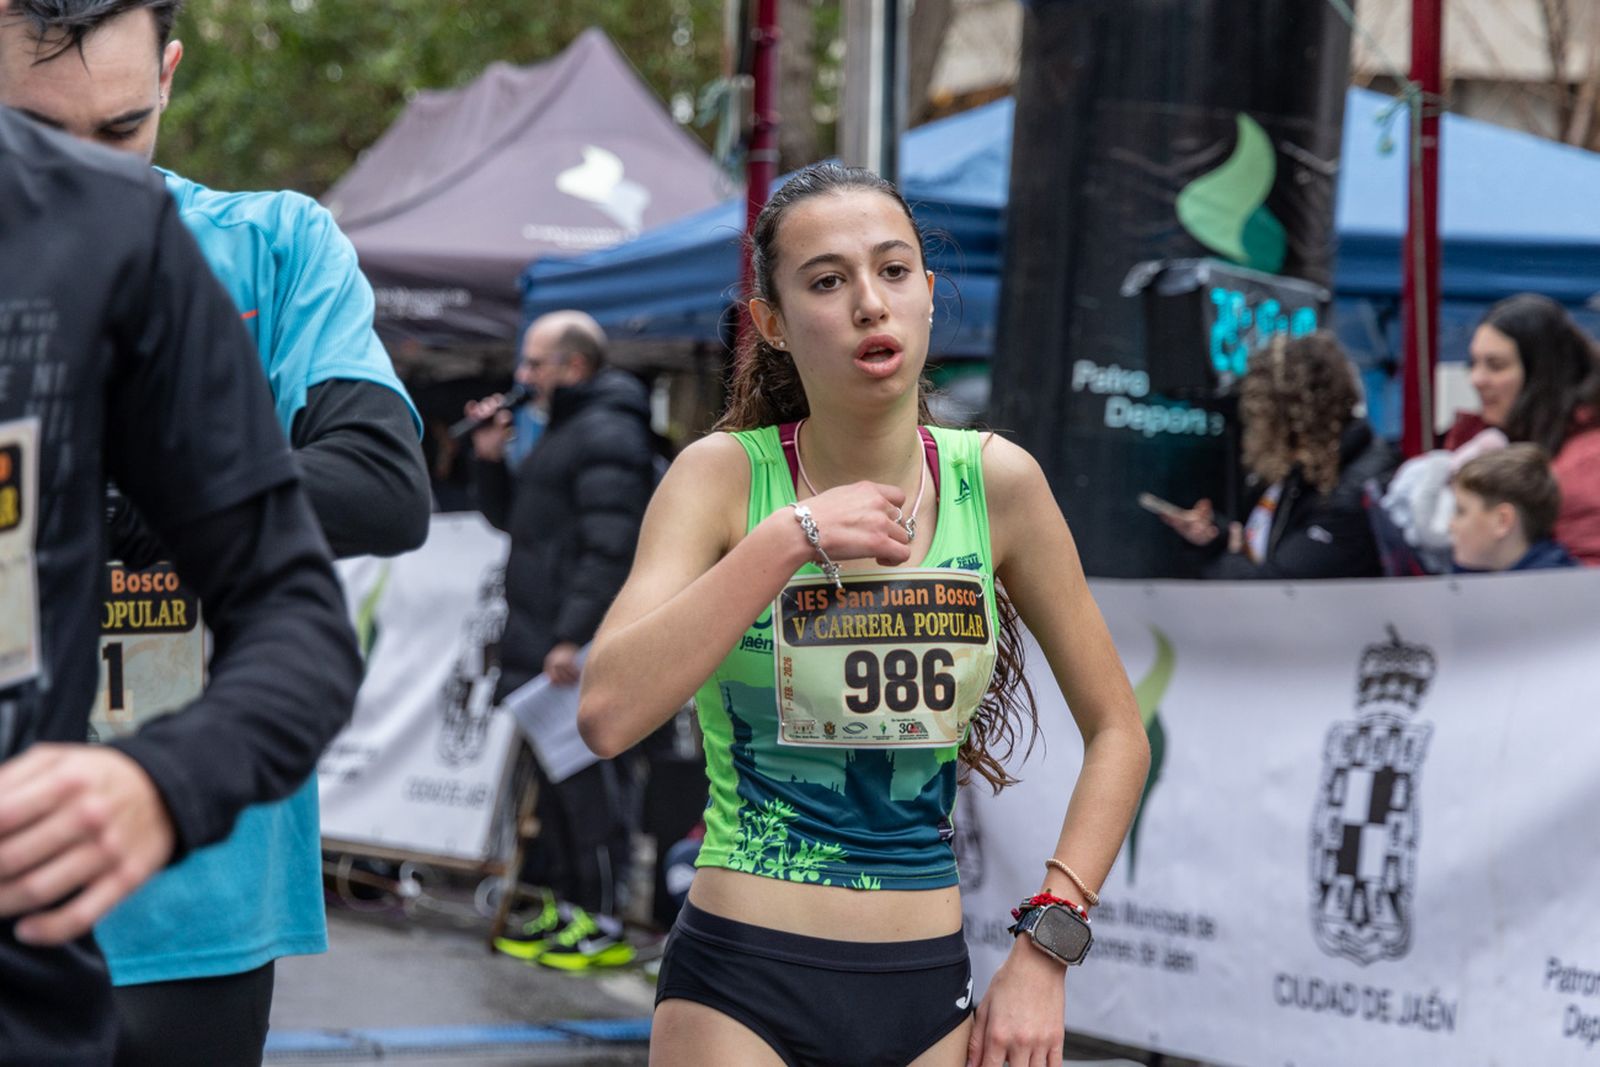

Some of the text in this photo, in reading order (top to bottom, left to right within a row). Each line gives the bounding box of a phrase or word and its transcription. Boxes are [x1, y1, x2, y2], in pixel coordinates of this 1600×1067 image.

[111, 569, 180, 594] Bosco
[797, 583, 977, 611] IES San Juan Bosco
[792, 611, 986, 640] V CARRERA POPULAR
[844, 648, 956, 714] 986
[1273, 972, 1360, 1018] CIUDAD
[1362, 985, 1393, 1023] DE
